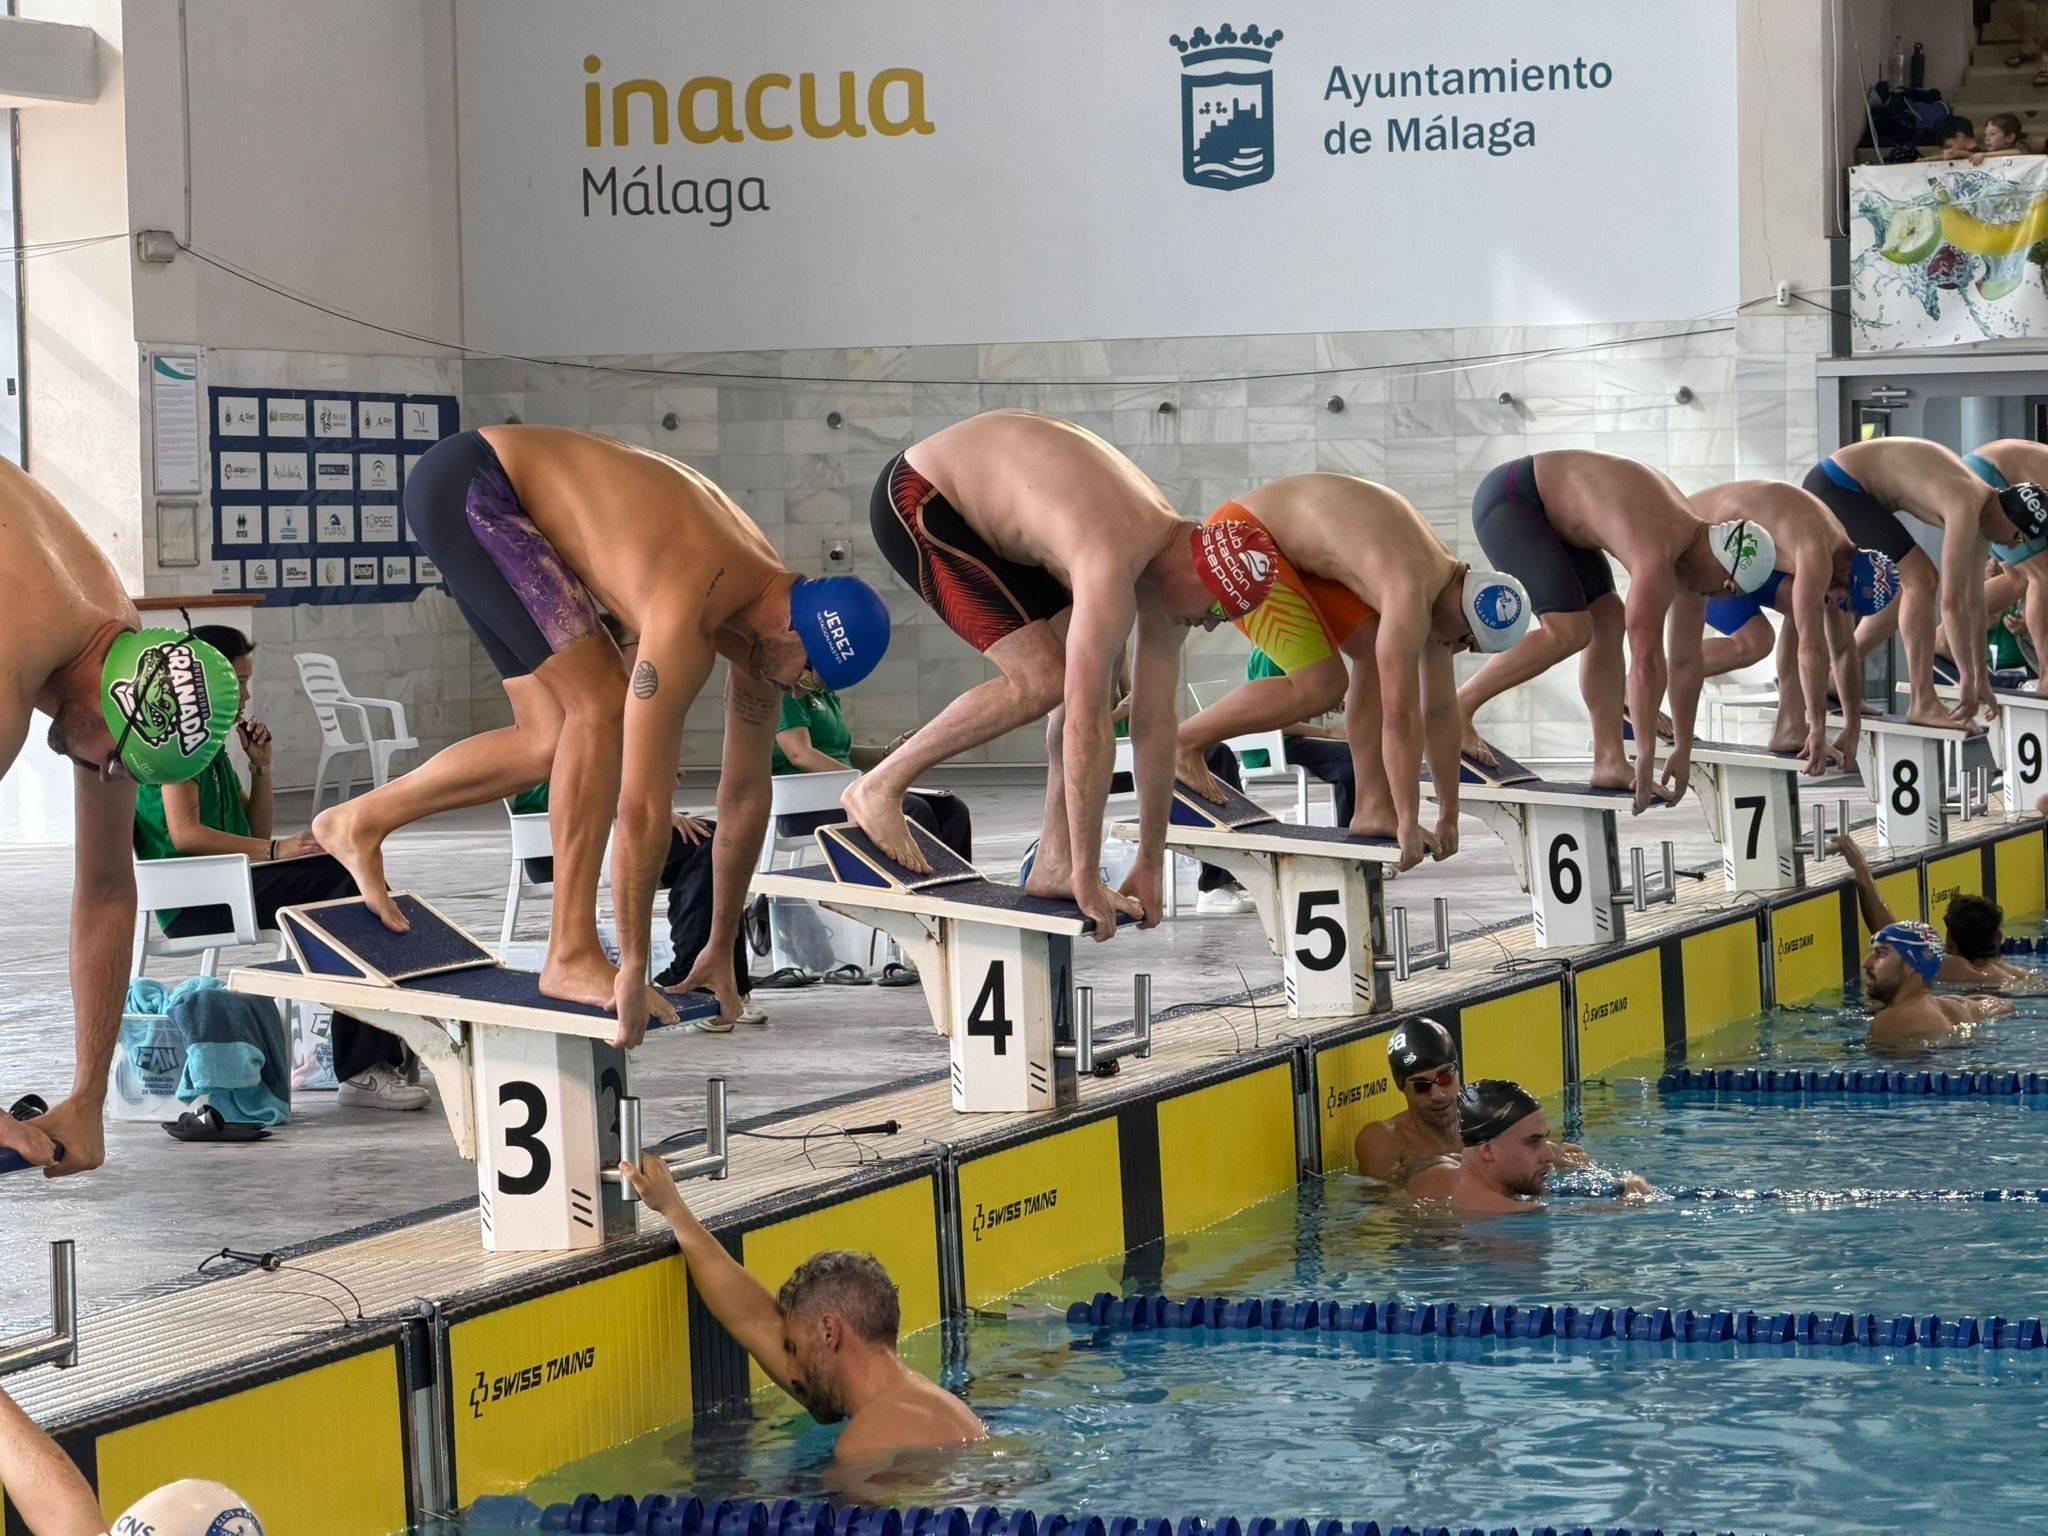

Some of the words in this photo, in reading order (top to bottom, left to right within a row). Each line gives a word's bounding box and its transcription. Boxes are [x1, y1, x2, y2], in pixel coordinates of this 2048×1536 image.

[583, 54, 935, 147] inacua
[1324, 57, 1613, 108] Ayuntamiento
[1324, 121, 1372, 155] de
[1387, 114, 1536, 156] Málaga
[582, 165, 770, 227] Málaga
[324, 526, 347, 536] TURBO
[365, 515, 394, 528] TOPSEC
[1215, 523, 1251, 591] natación
[824, 610, 855, 661] JEREZ
[162, 645, 207, 753] GRANADA
[193, 661, 210, 719] UNIVERSIDAD
[2018, 732, 2042, 784] 9
[1891, 759, 1920, 816] 8
[1734, 795, 1766, 860] 7
[1548, 832, 1582, 905] 6
[1295, 889, 1346, 972] 5
[967, 959, 1013, 1056] 4
[1590, 1003, 1608, 1022] SWISS
[1337, 1085, 1362, 1108] SWISS
[1363, 1077, 1388, 1099] TIMING
[497, 1080, 552, 1196] 3
[987, 1200, 1021, 1230] SWISS
[1023, 1188, 1057, 1217] TIMING
[491, 1364, 543, 1402] SWISS
[546, 1346, 595, 1383] TIMING
